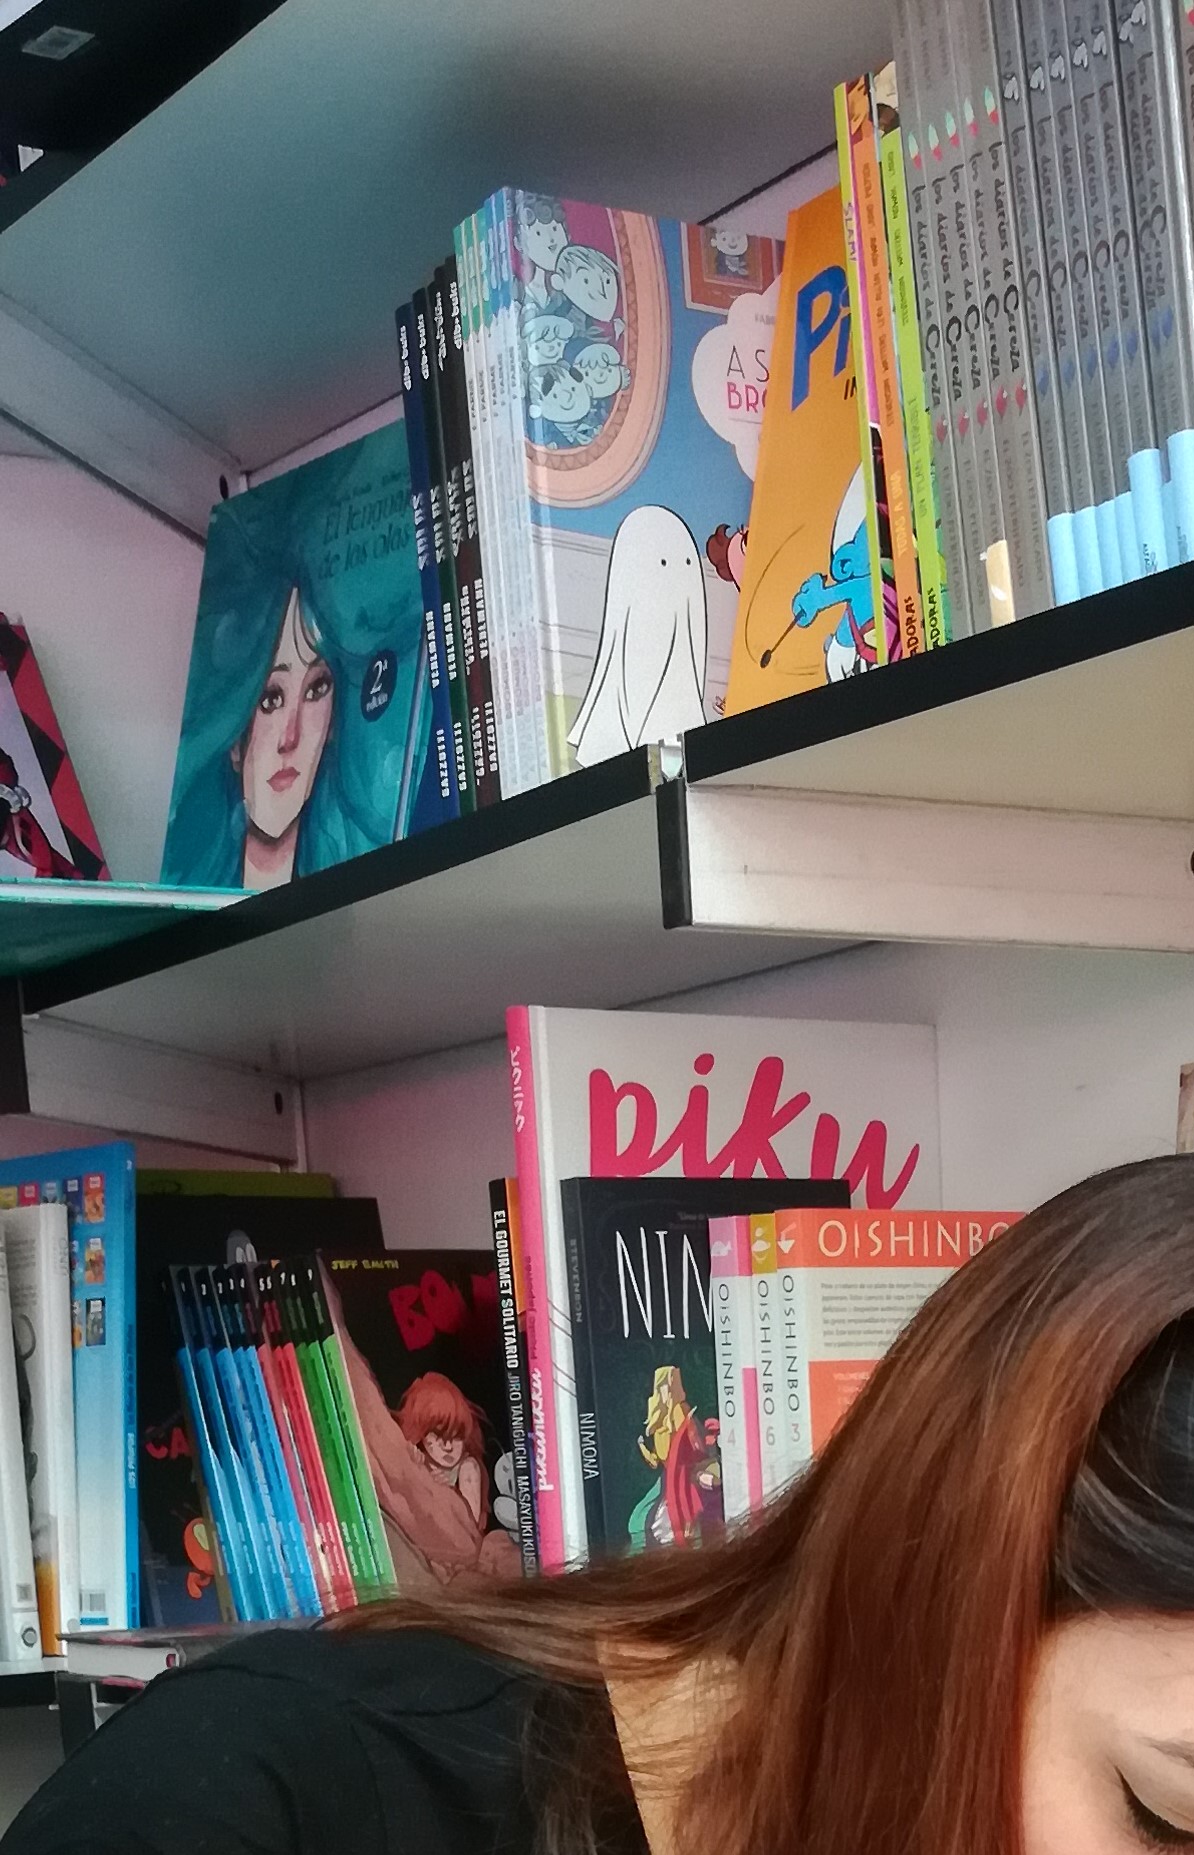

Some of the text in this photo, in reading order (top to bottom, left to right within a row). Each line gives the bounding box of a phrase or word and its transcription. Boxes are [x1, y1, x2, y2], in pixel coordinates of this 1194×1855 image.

[955, 201, 970, 271] diarios
[995, 178, 1009, 250] diarios
[917, 221, 933, 291] diarios
[964, 279, 974, 300] de
[1003, 258, 1014, 281] de
[925, 298, 934, 320] de
[1004, 284, 1020, 372] Cereza
[926, 323, 942, 409] Cereza
[964, 304, 981, 390] Cereza
[589, 1053, 920, 1210] piku
[493, 1210, 506, 1228] EL
[494, 1230, 512, 1296] GOURMET
[501, 1299, 518, 1370] SOLITARIO
[719, 1283, 735, 1418] OISHINBO
[758, 1279, 776, 1446] OISHINBO 6
[782, 1274, 801, 1442] OISHINBO 3
[506, 1372, 522, 1401] JIRO
[510, 1405, 527, 1470] TANIGUCHI
[579, 1412, 599, 1480] NIMONA
[516, 1475, 534, 1536] MASAYUKI
